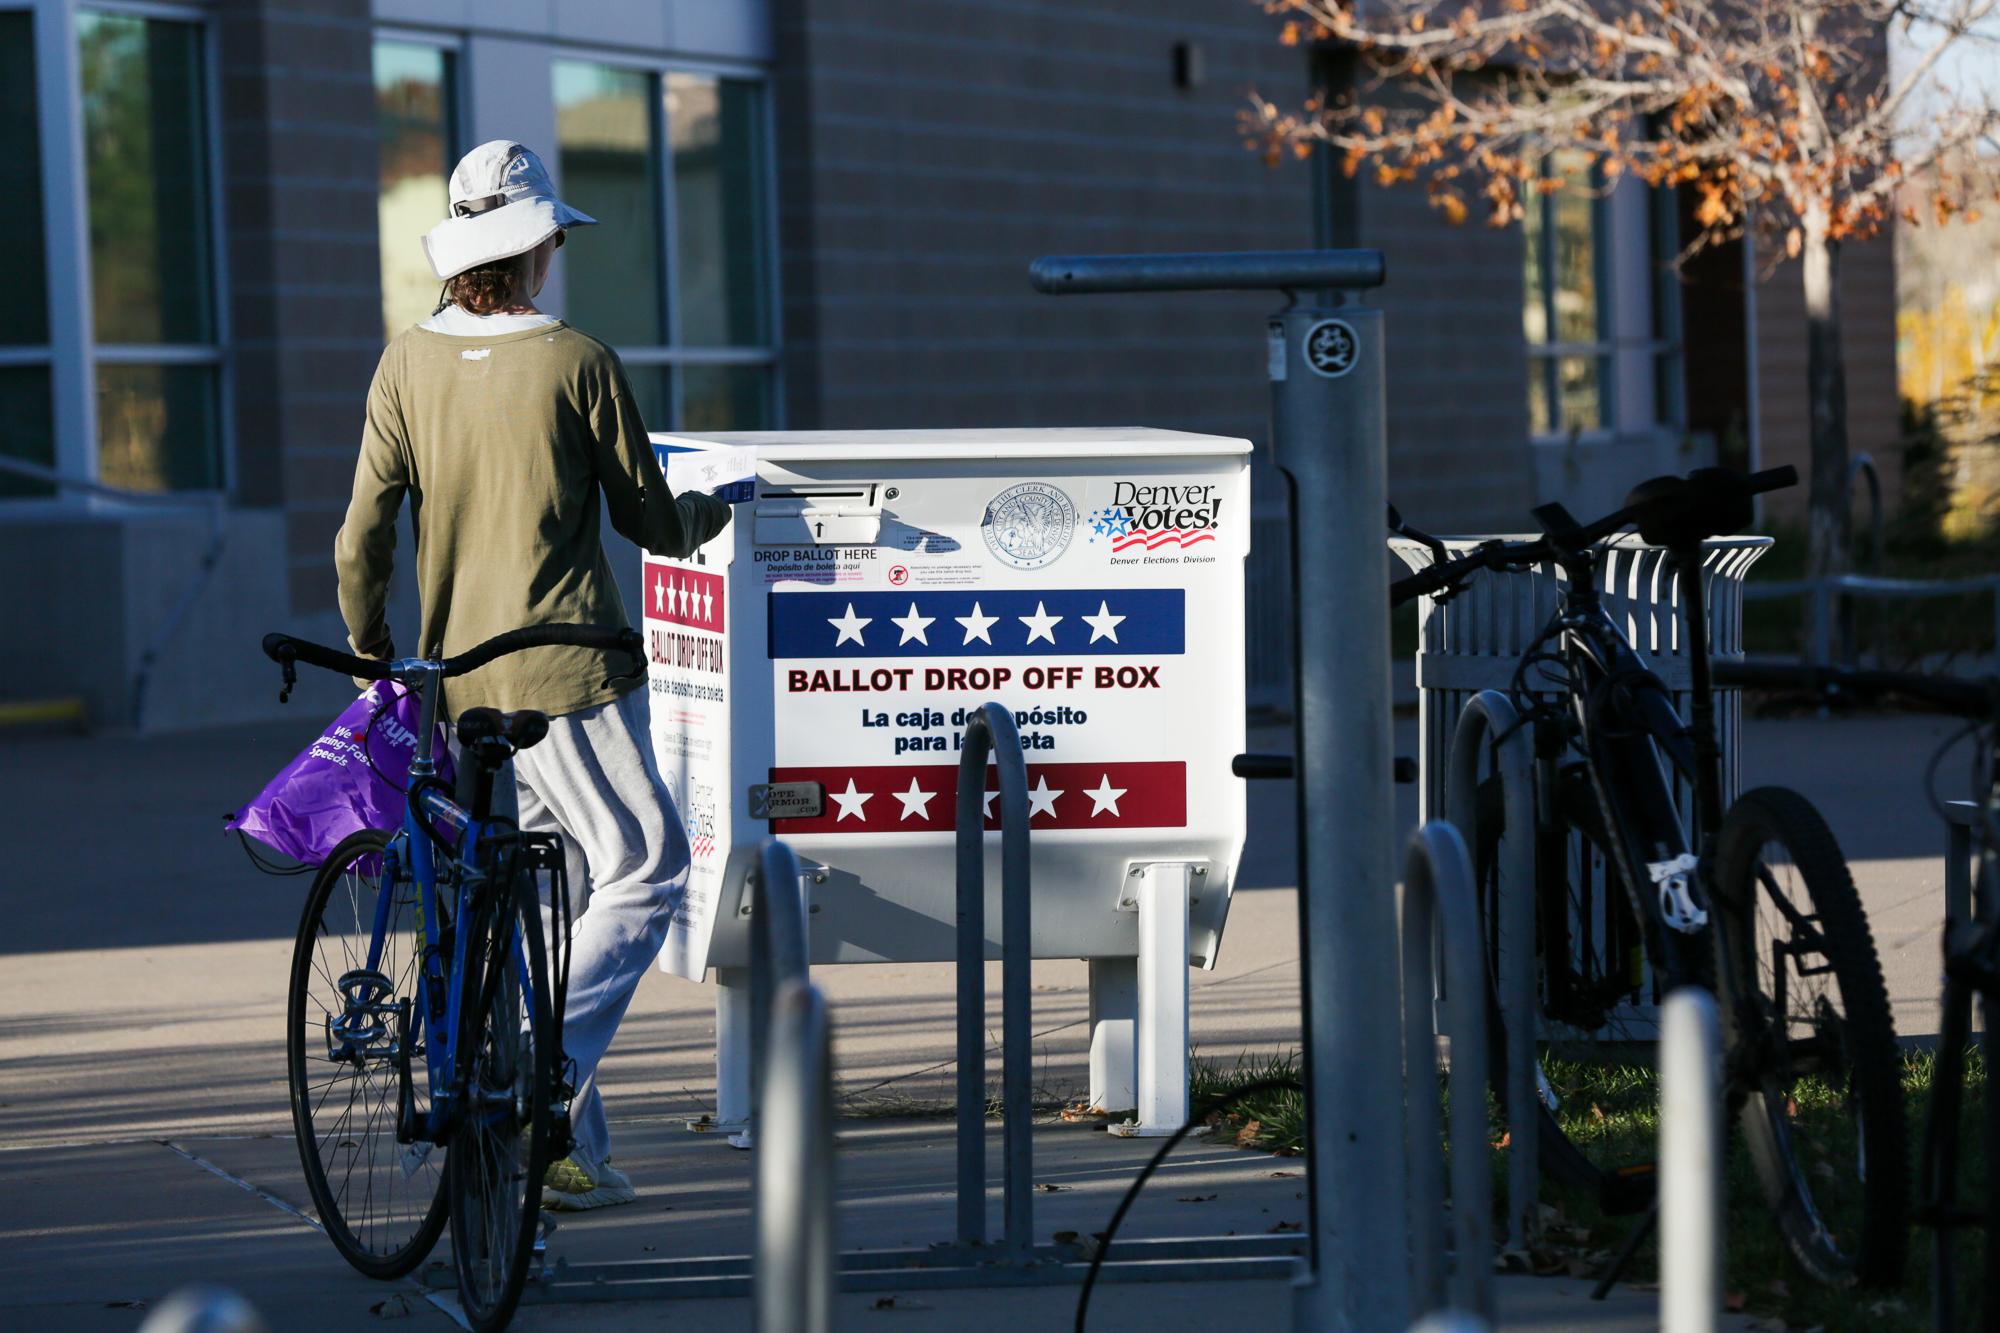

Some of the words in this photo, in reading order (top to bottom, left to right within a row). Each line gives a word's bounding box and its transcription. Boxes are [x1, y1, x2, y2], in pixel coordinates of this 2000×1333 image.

[1015, 485, 1044, 494] CLERK
[1047, 490, 1064, 503] AND
[1112, 481, 1216, 506] Denver
[1124, 498, 1223, 531] Votes!
[754, 551, 790, 562] DROP
[793, 549, 840, 561] BALLOT
[844, 549, 877, 559] HERE
[803, 562, 817, 570] de
[815, 561, 840, 570] boleta
[1110, 557, 1140, 565] Denver
[1143, 556, 1180, 564] Elections
[1183, 555, 1216, 564] Division
[652, 629, 675, 666] BALLOT
[677, 633, 695, 669] DROP
[697, 636, 708, 671] OFF
[710, 638, 723, 674] BOX
[788, 669, 914, 692] BALLOT
[925, 668, 1012, 691] DROP
[1022, 667, 1083, 690] OFF
[1094, 666, 1161, 689] BOX
[862, 709, 889, 727] La
[896, 708, 945, 731] caja
[1010, 705, 1087, 729] pósito
[334, 725, 351, 739] We
[895, 735, 947, 754] para
[953, 732, 965, 750] l
[309, 745, 348, 767] Speeds
